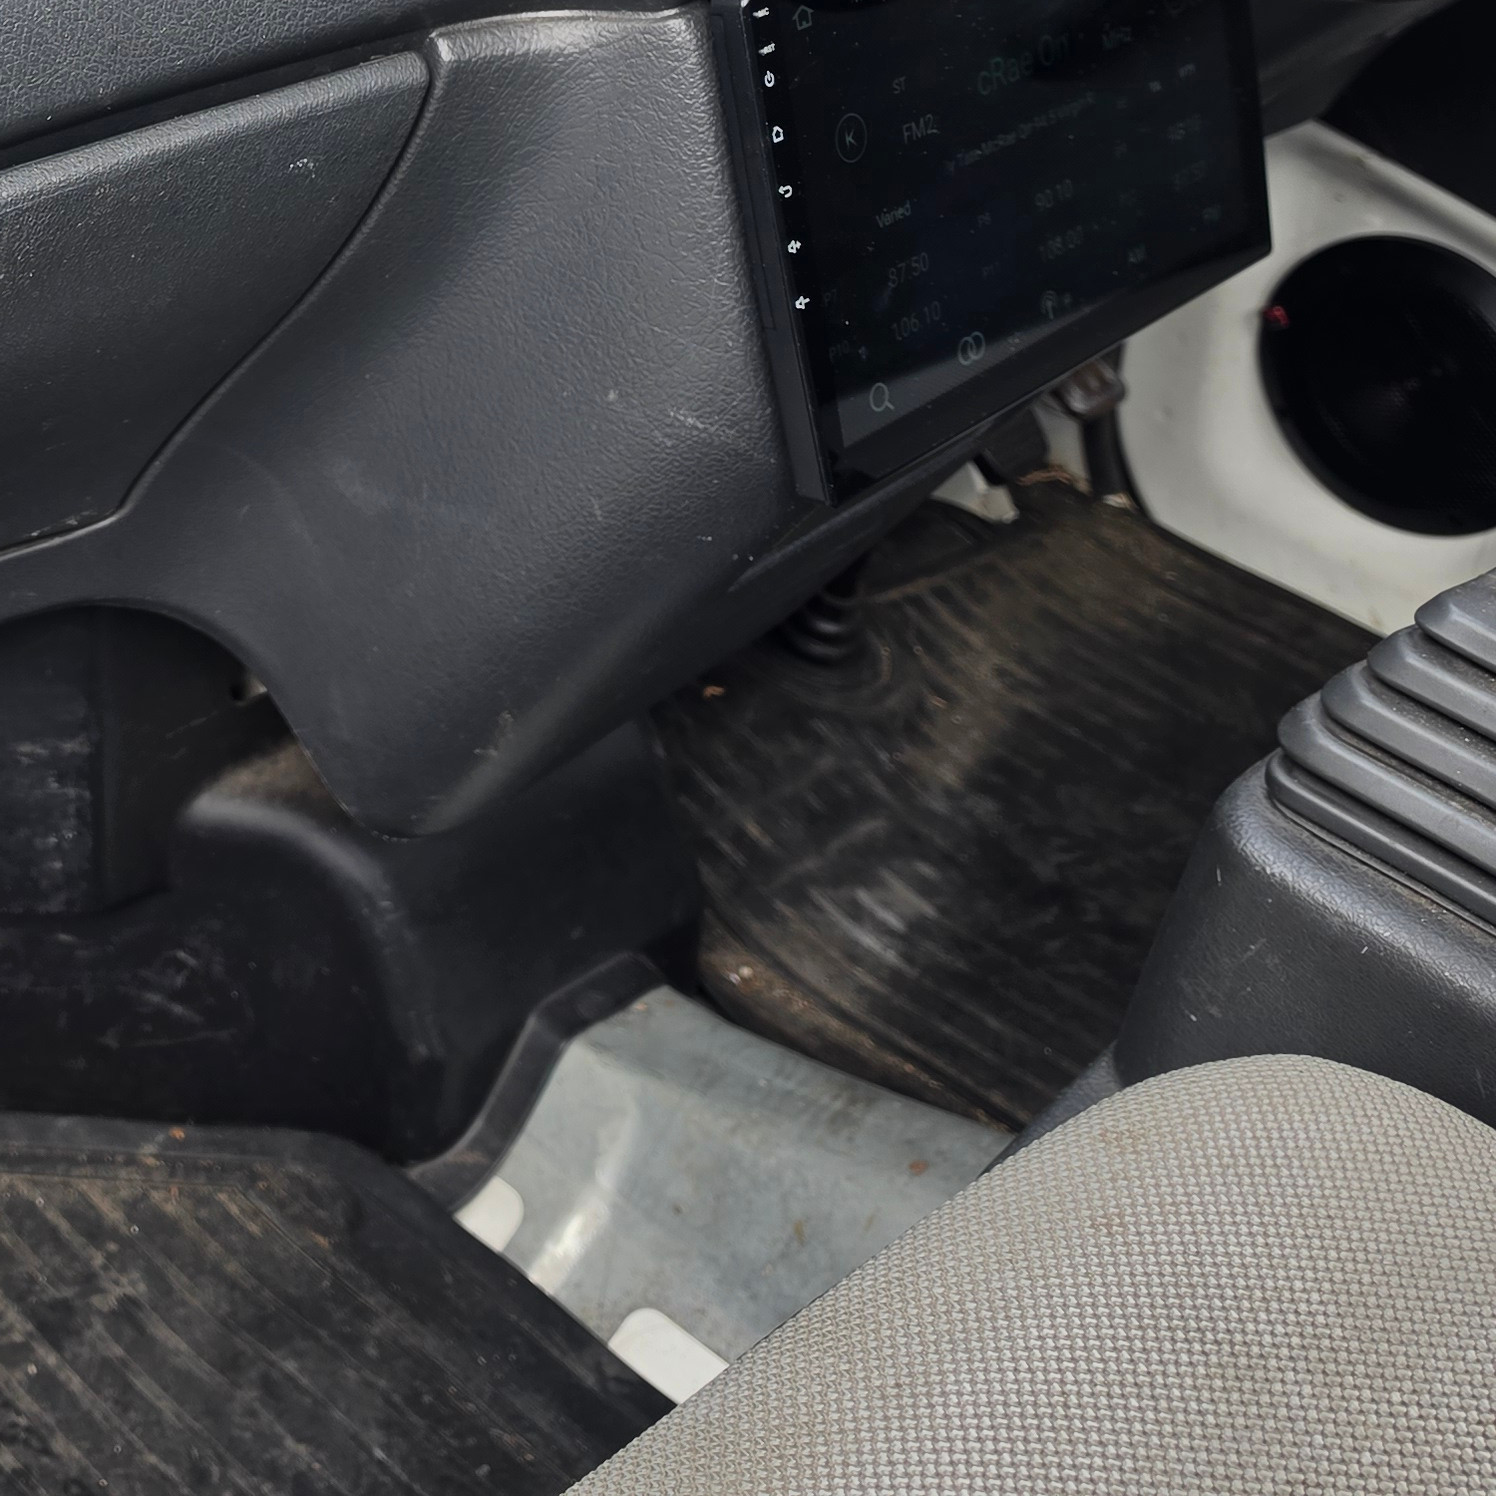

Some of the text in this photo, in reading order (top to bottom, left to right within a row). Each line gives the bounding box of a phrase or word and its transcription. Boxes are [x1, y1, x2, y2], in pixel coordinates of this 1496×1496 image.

[892, 75, 907, 95] ST
[902, 113, 941, 145] FM2
[875, 199, 912, 228] Varied
[887, 251, 929, 288] 87.50
[890, 300, 942, 341] 106.10
